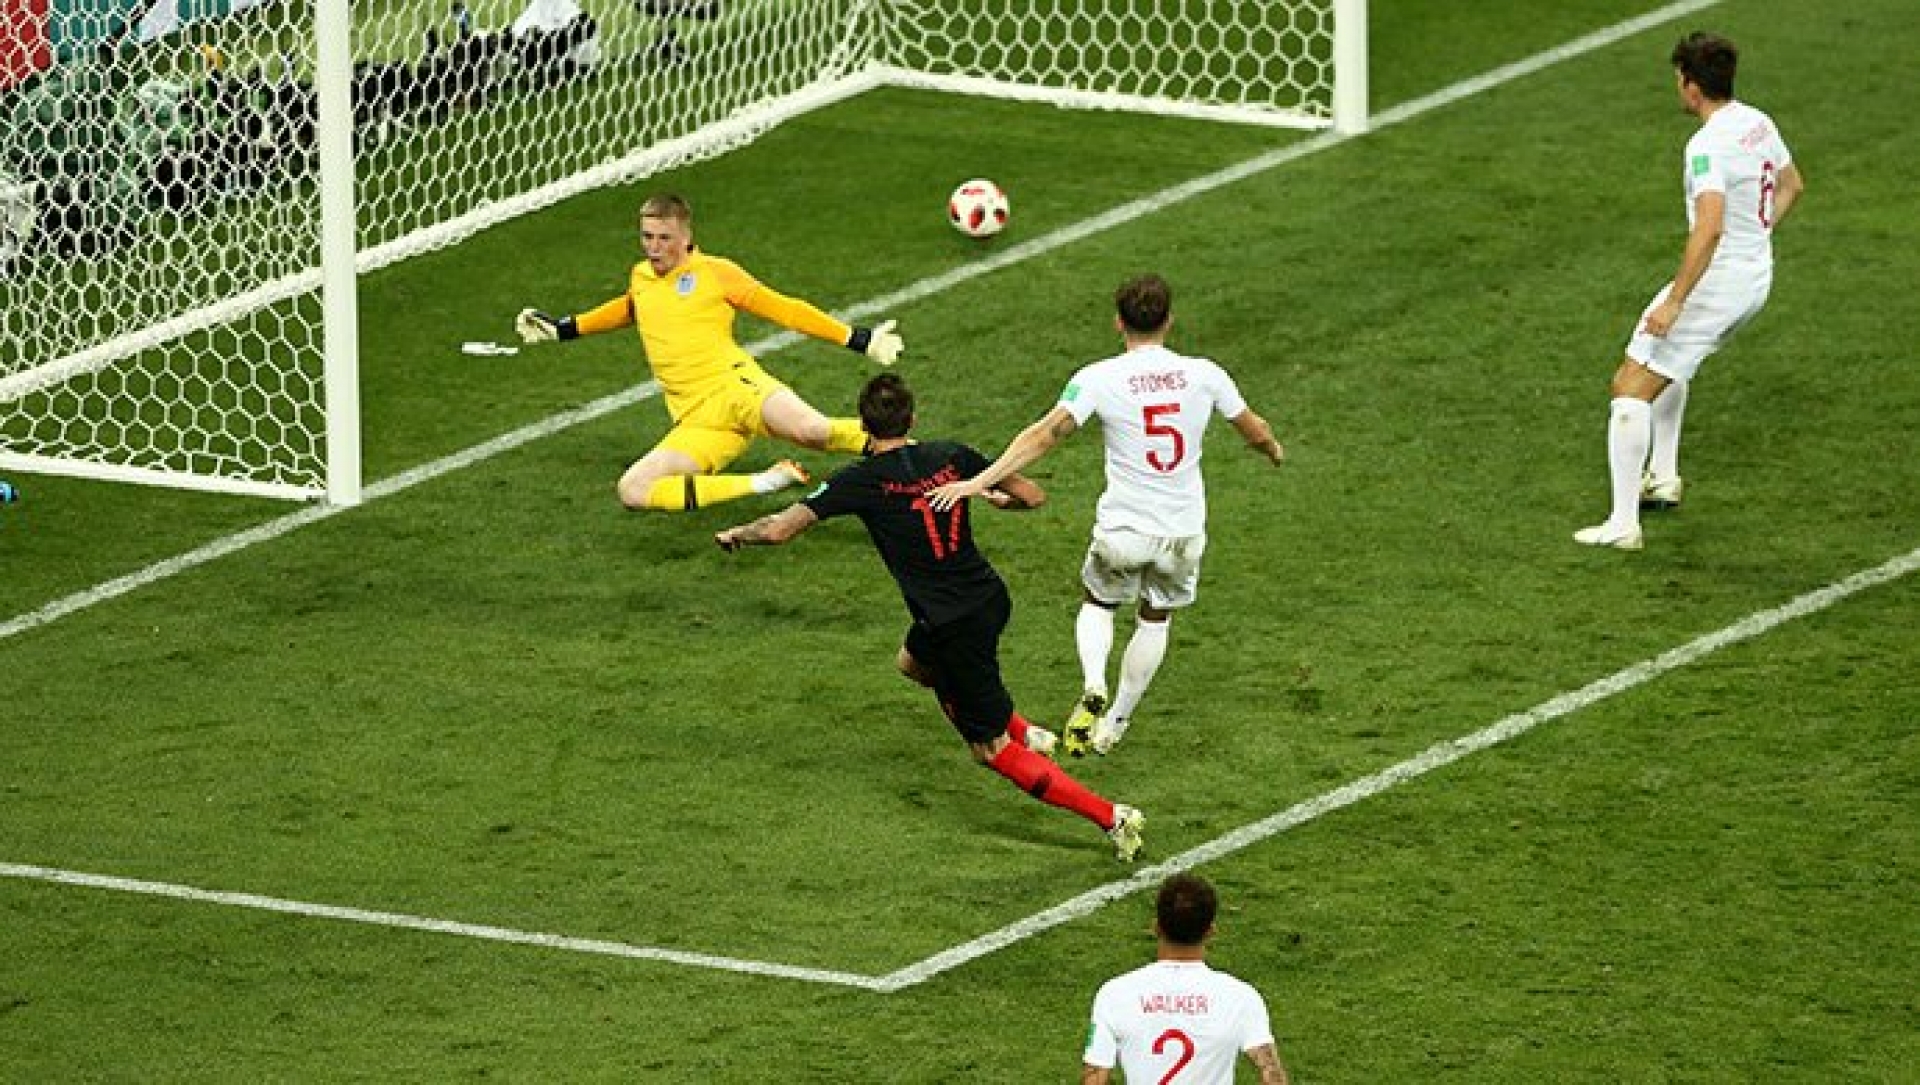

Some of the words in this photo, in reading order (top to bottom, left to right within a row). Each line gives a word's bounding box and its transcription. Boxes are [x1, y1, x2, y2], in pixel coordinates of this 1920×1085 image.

[1128, 370, 1189, 394] STONES
[1143, 402, 1186, 473] 5
[1140, 994, 1209, 1015] WALKER
[1151, 1028, 1196, 1085] 2
